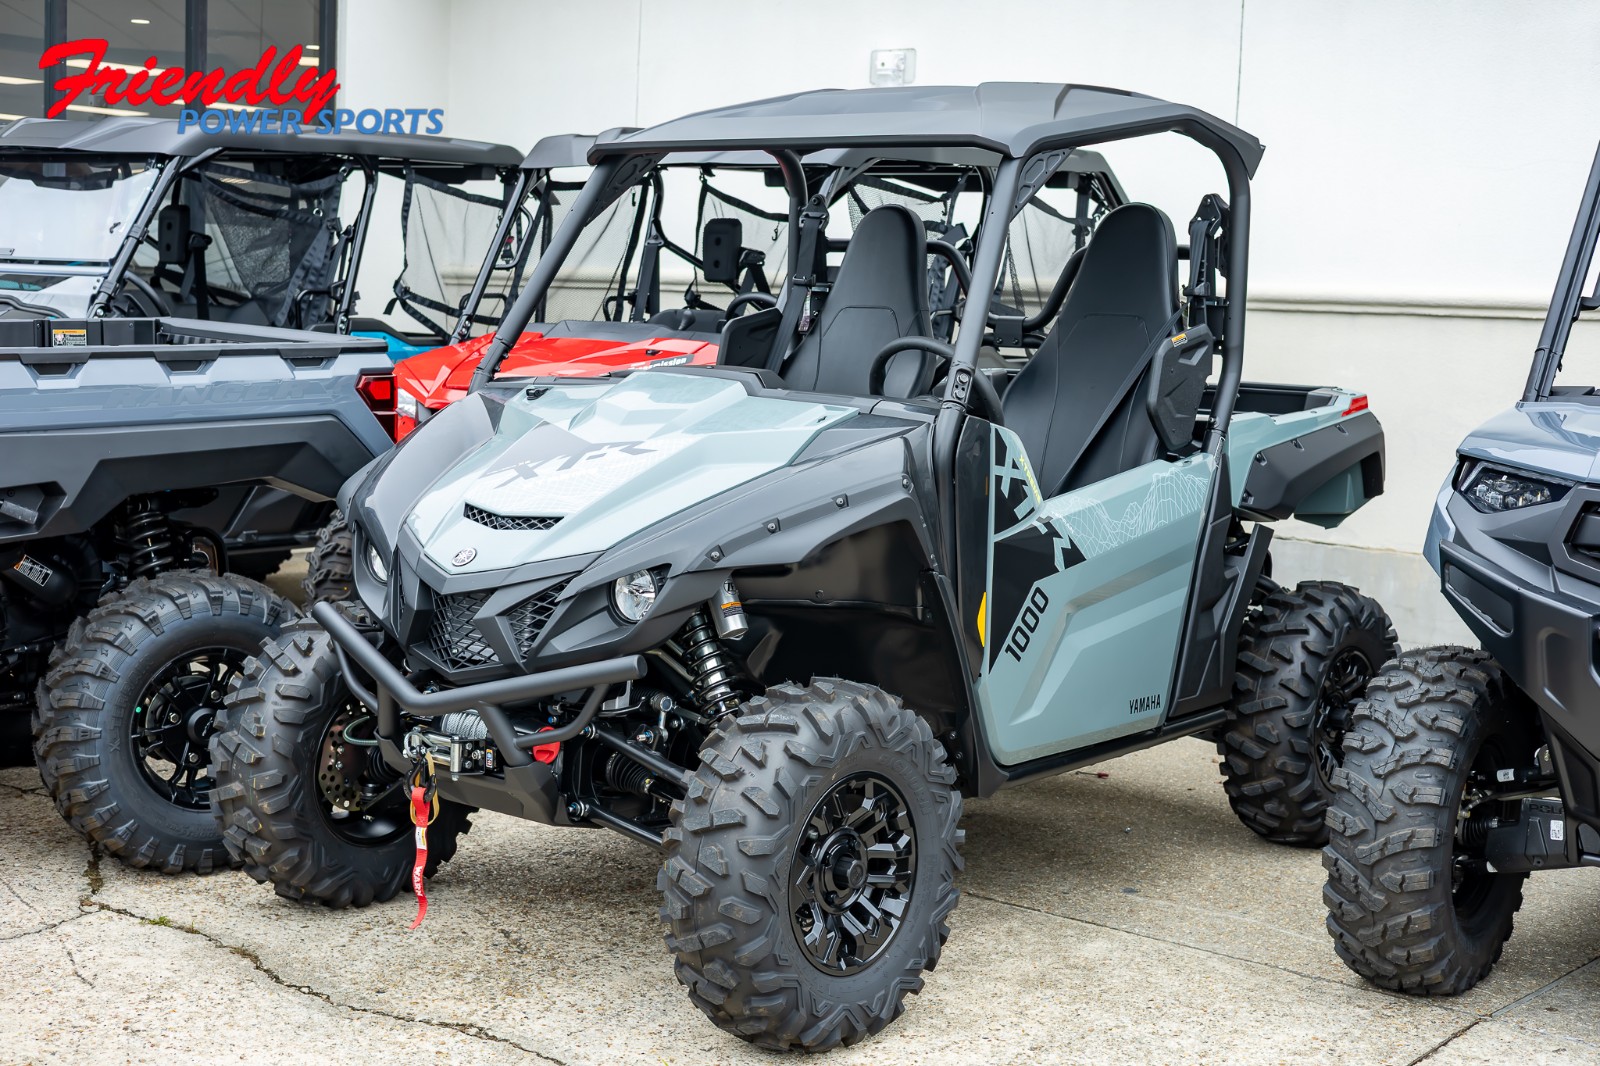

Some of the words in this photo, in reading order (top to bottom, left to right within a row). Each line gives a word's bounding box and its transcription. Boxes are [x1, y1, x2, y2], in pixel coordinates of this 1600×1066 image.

[102, 380, 306, 409] RANGER
[1005, 586, 1049, 662] 1000
[1129, 694, 1161, 715] YAMAHA
[413, 865, 423, 897] WARN
